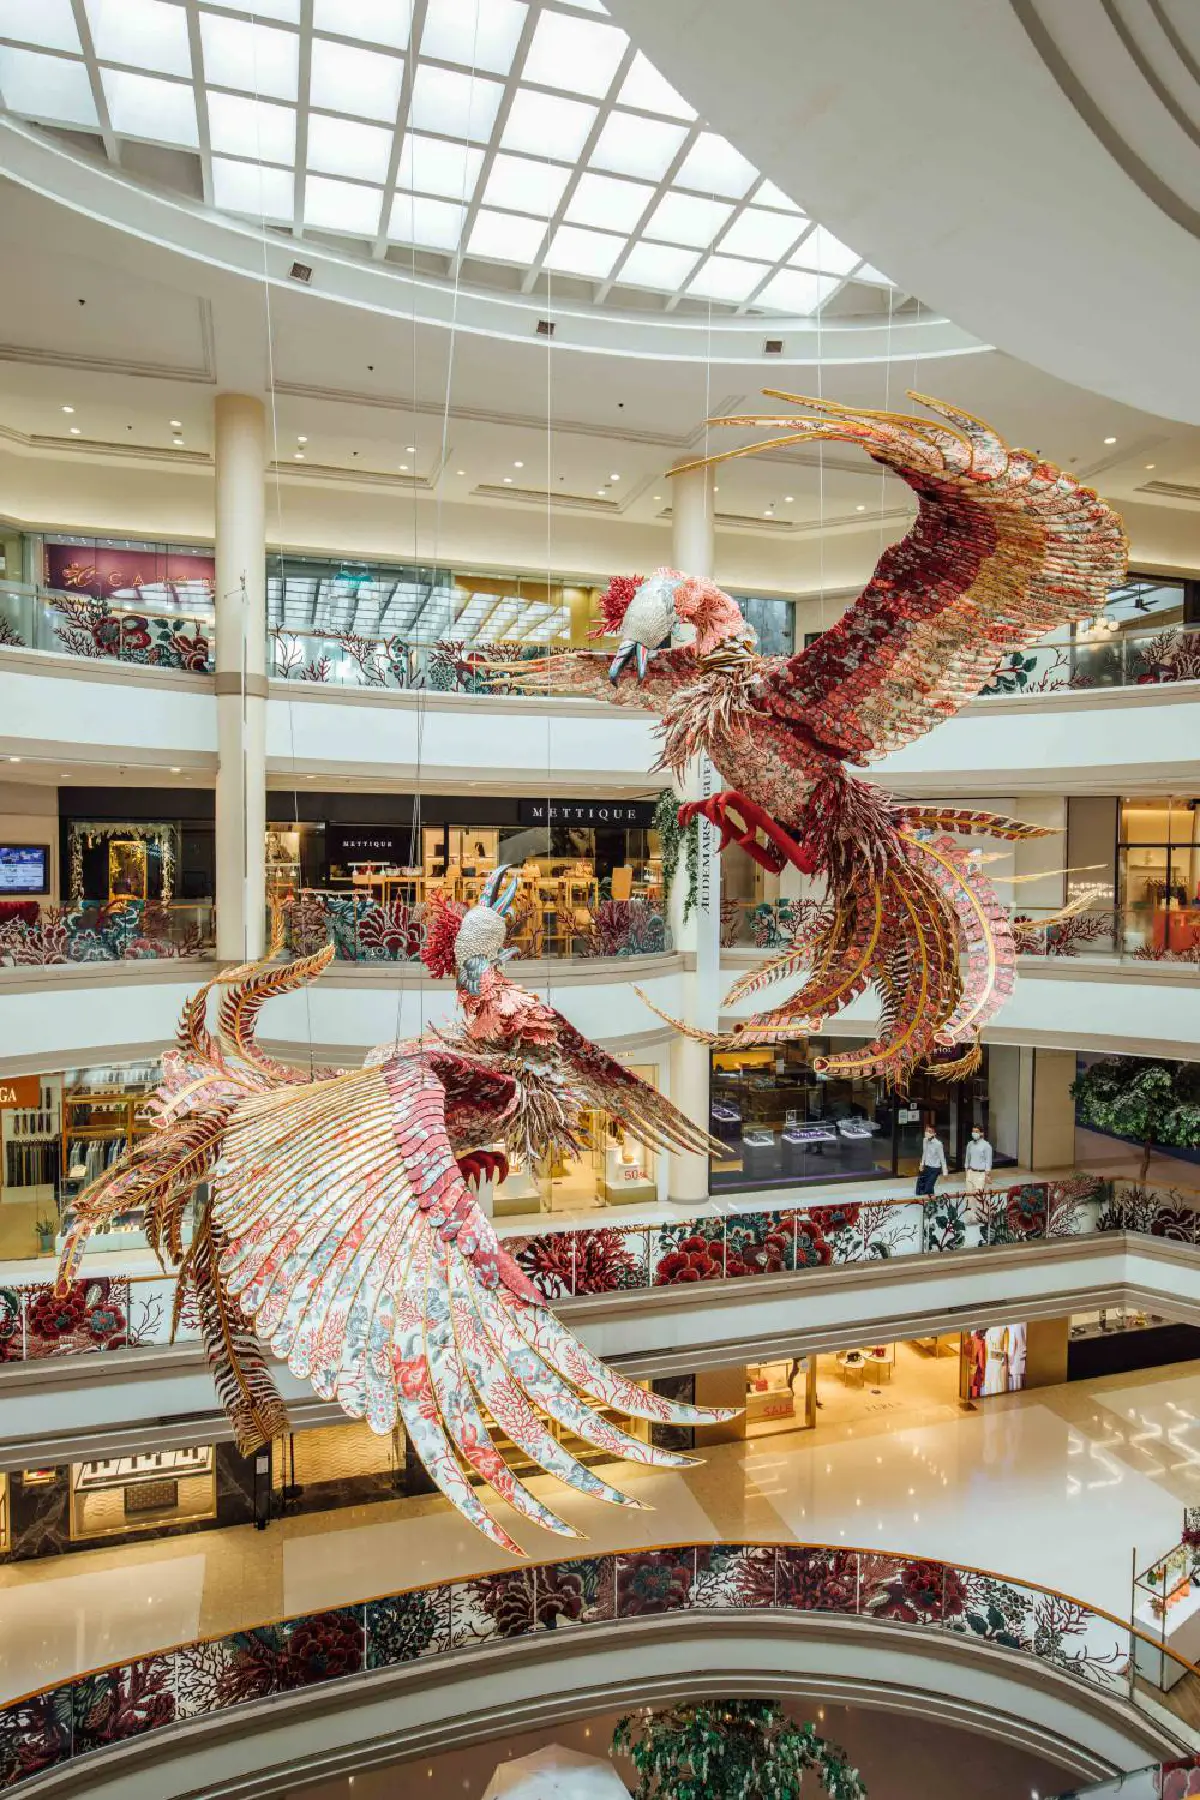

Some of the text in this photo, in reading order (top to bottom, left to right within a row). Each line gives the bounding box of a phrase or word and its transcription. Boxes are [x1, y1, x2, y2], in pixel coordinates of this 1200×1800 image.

[532, 807, 636, 821] METTIQUE
[701, 821, 710, 915] AUDEMARS
[763, 1404, 794, 1417] SALE
